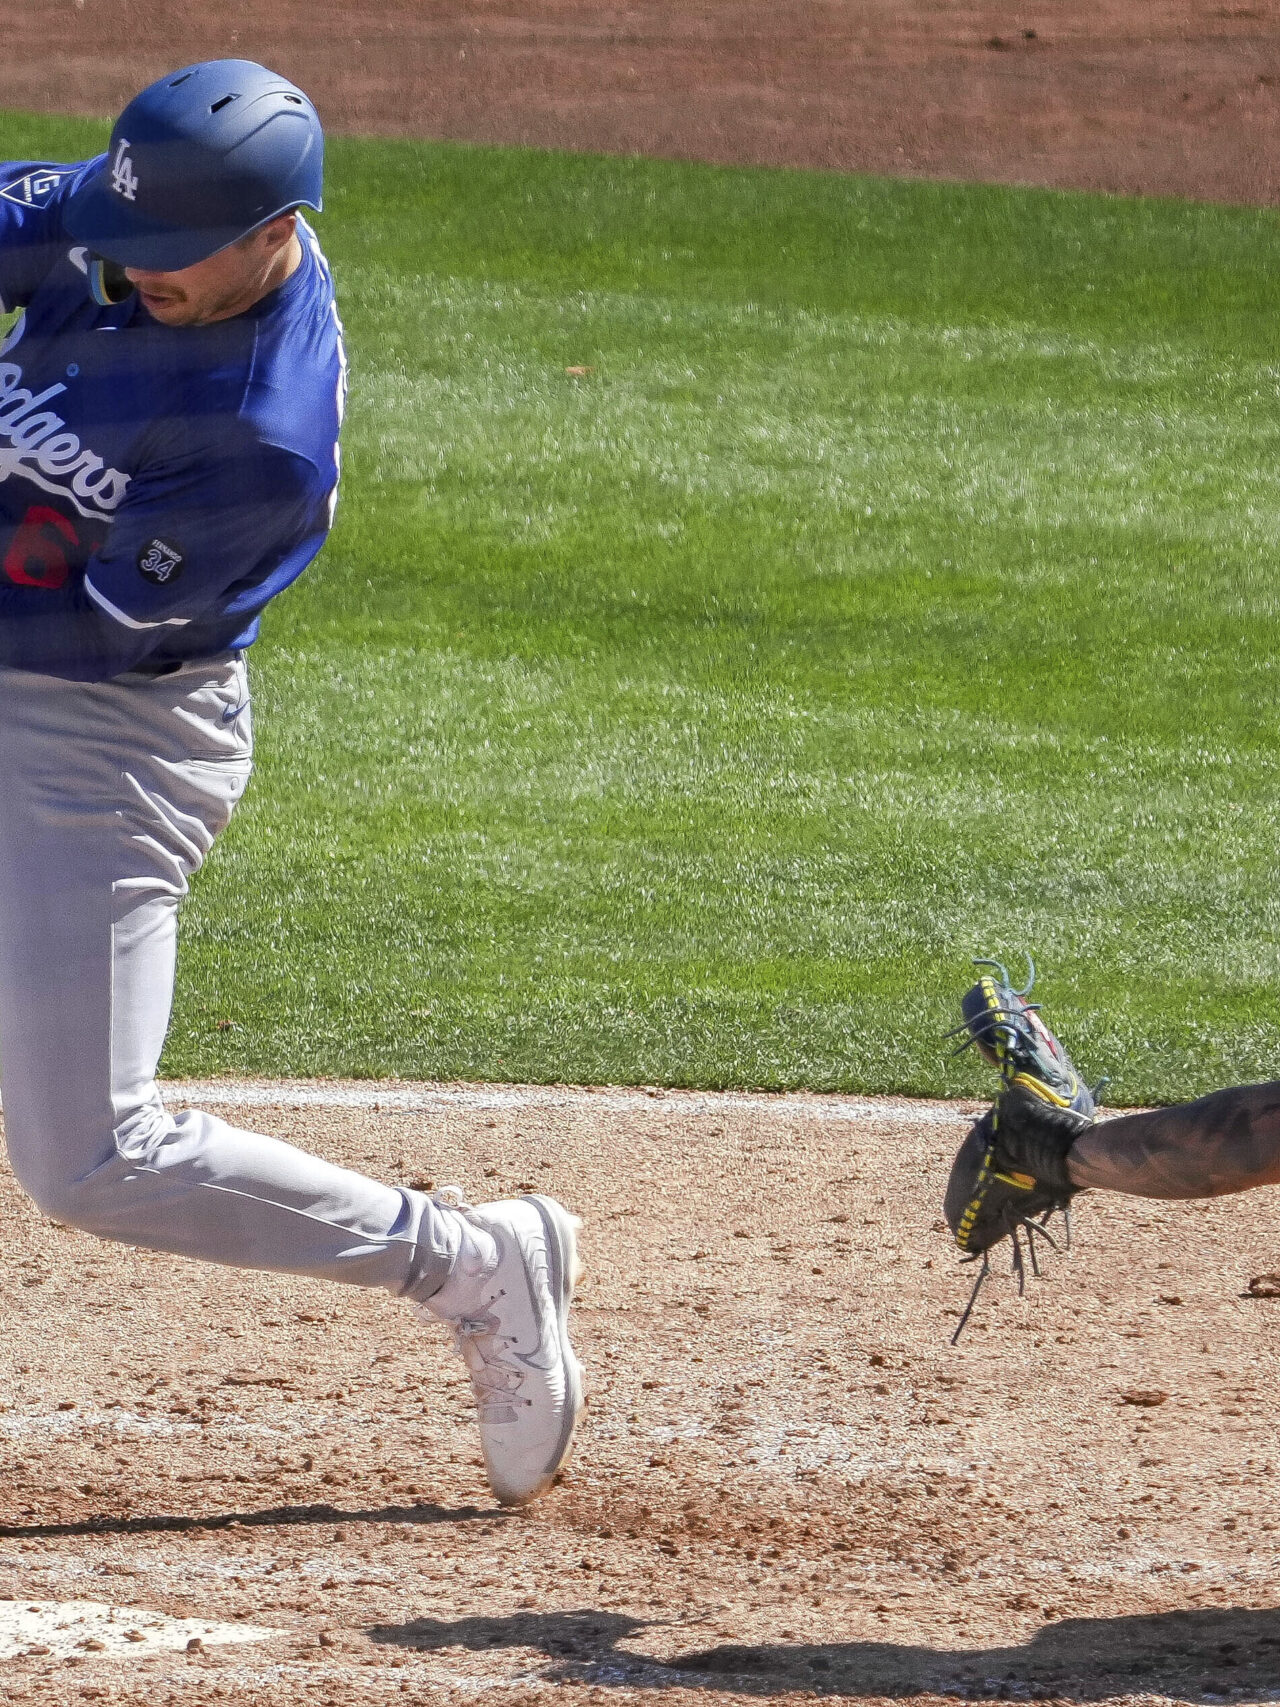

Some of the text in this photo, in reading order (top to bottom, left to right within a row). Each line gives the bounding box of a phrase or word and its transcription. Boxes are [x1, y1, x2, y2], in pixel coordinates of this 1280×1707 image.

[112, 137, 139, 201] LA
[3, 504, 102, 589] 6
[140, 548, 177, 582] 34
